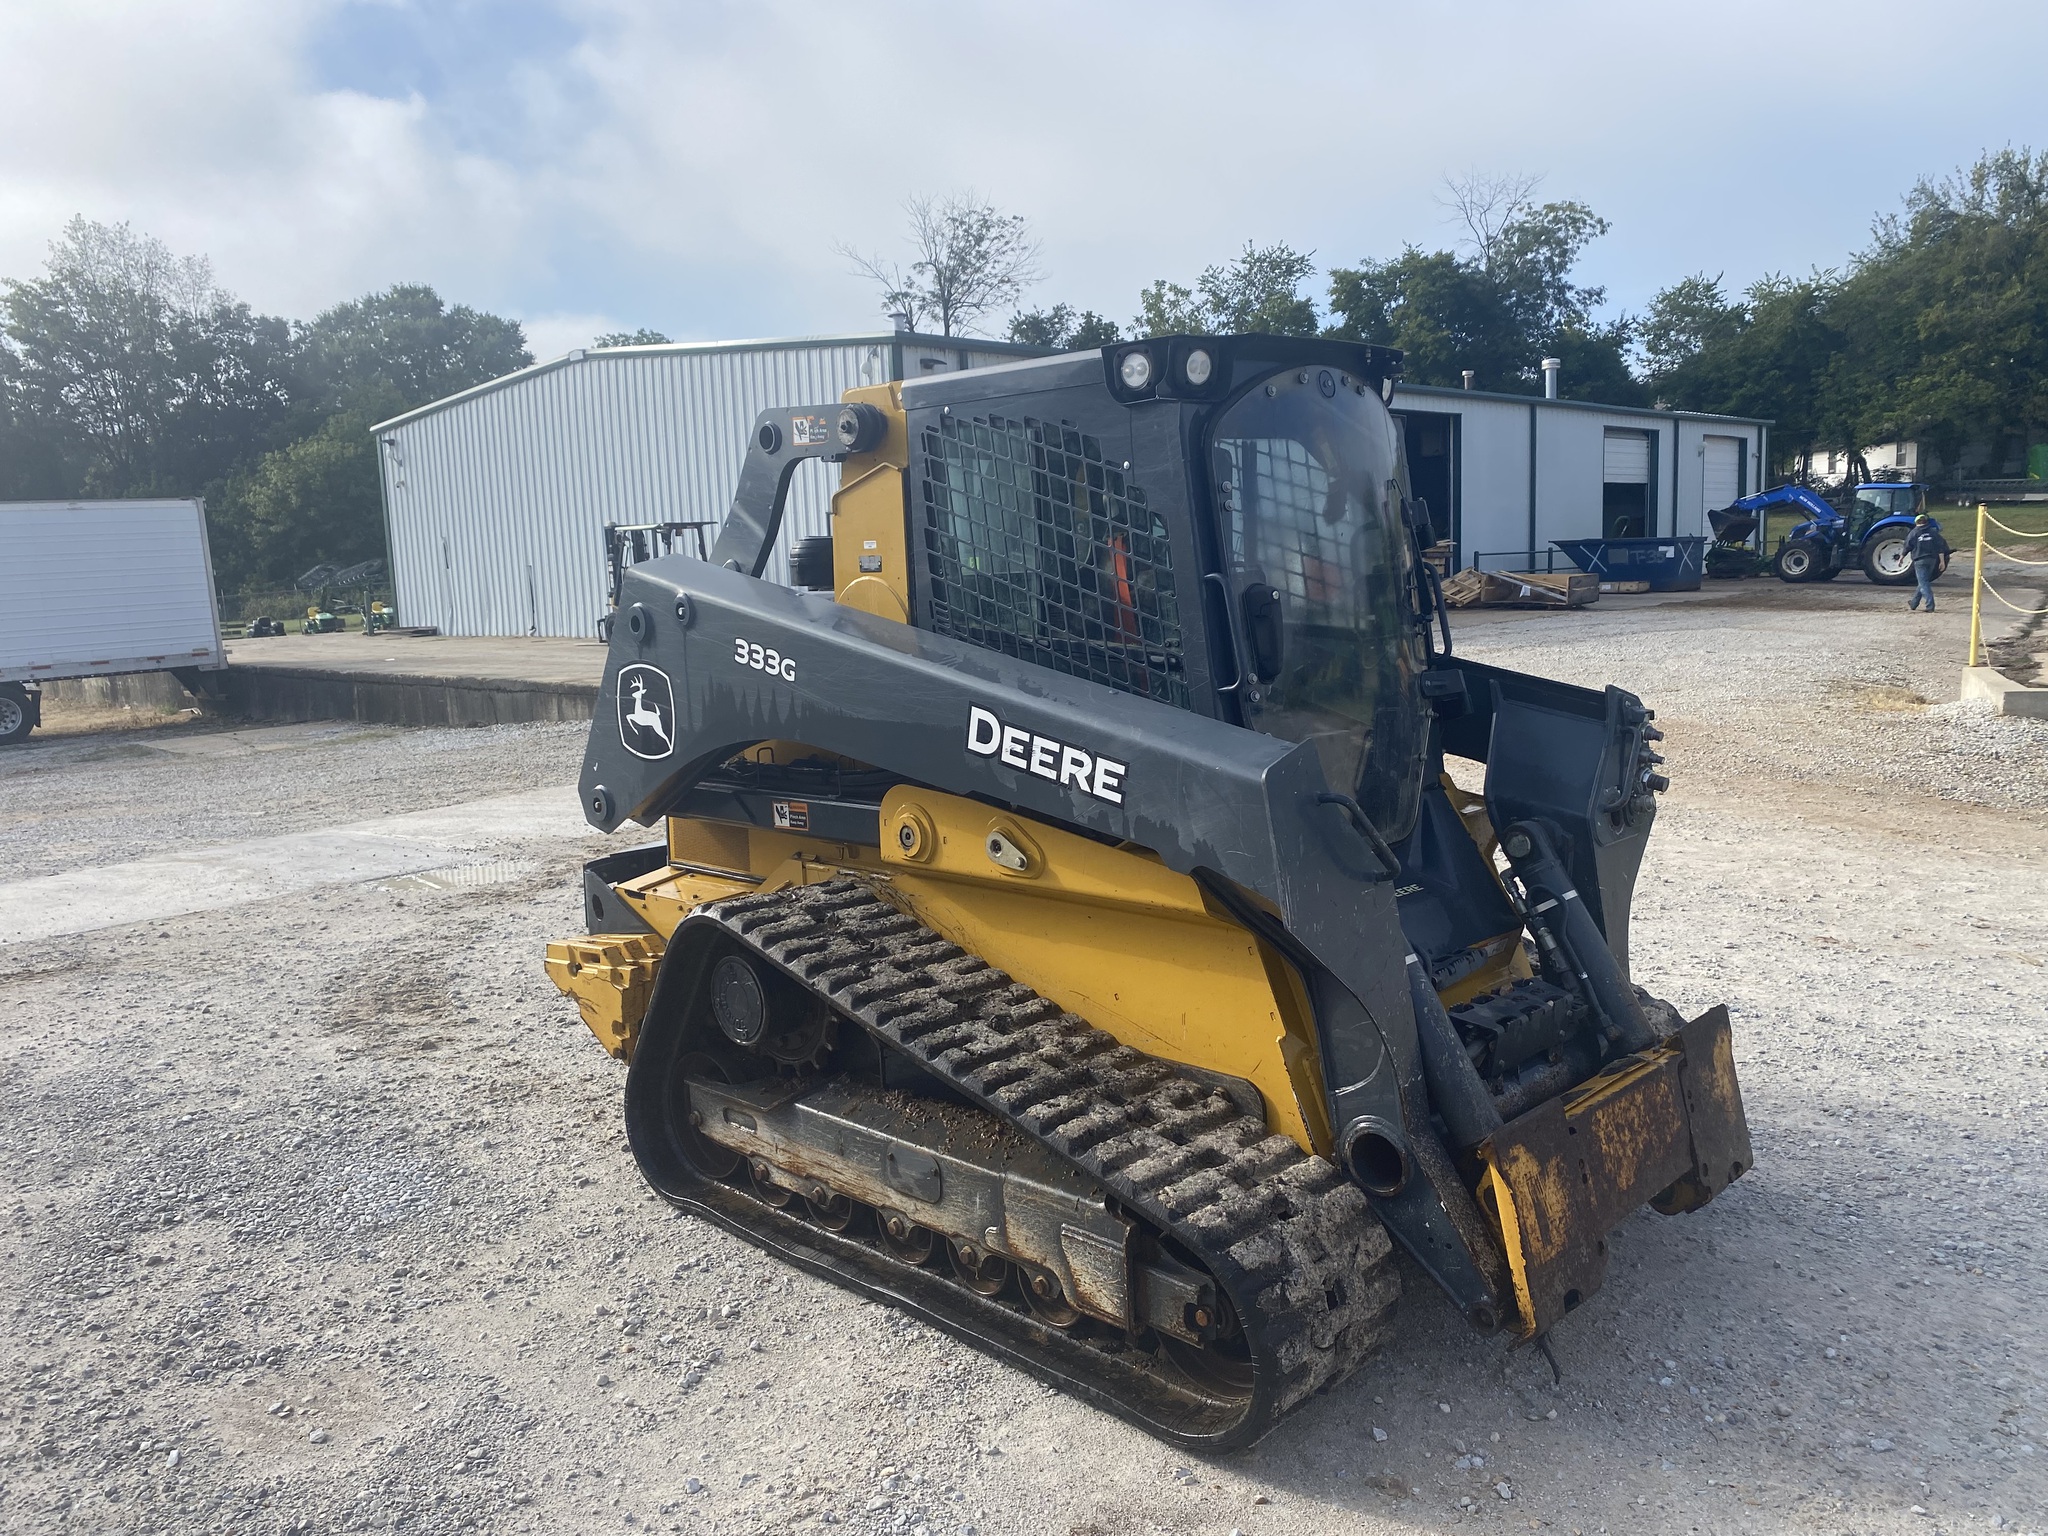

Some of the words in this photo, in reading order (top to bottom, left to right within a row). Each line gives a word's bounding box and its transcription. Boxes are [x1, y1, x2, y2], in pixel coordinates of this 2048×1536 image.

[734, 638, 796, 682] 333G
[967, 705, 1126, 804] DEERE
[1394, 884, 1425, 897] EERE
